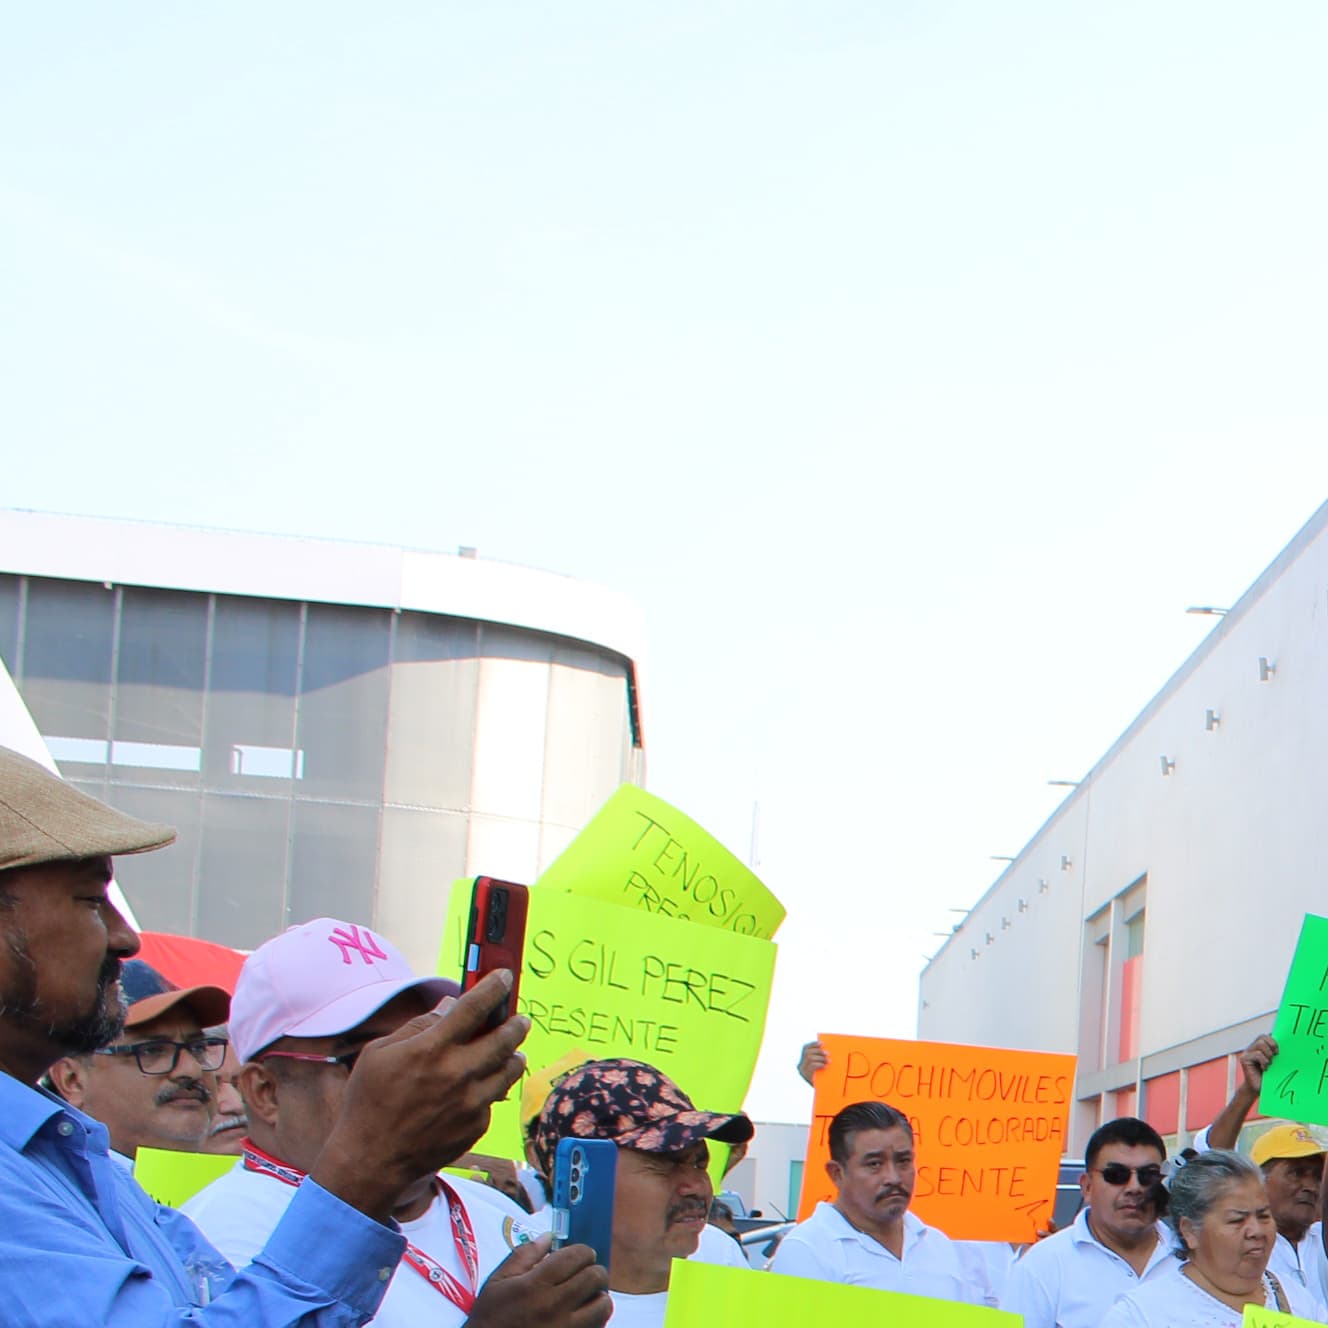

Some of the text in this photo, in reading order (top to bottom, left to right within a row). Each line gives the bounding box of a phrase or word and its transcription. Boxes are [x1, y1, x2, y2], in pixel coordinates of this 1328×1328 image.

[633, 811, 770, 939] TENOSIQ
[568, 938, 630, 991] GIL
[641, 955, 756, 1022] PEREZ
[842, 1051, 1068, 1104] POCHIMOVILES
[938, 1114, 1062, 1147] COLORADA
[914, 1166, 1029, 1198] SENTE
